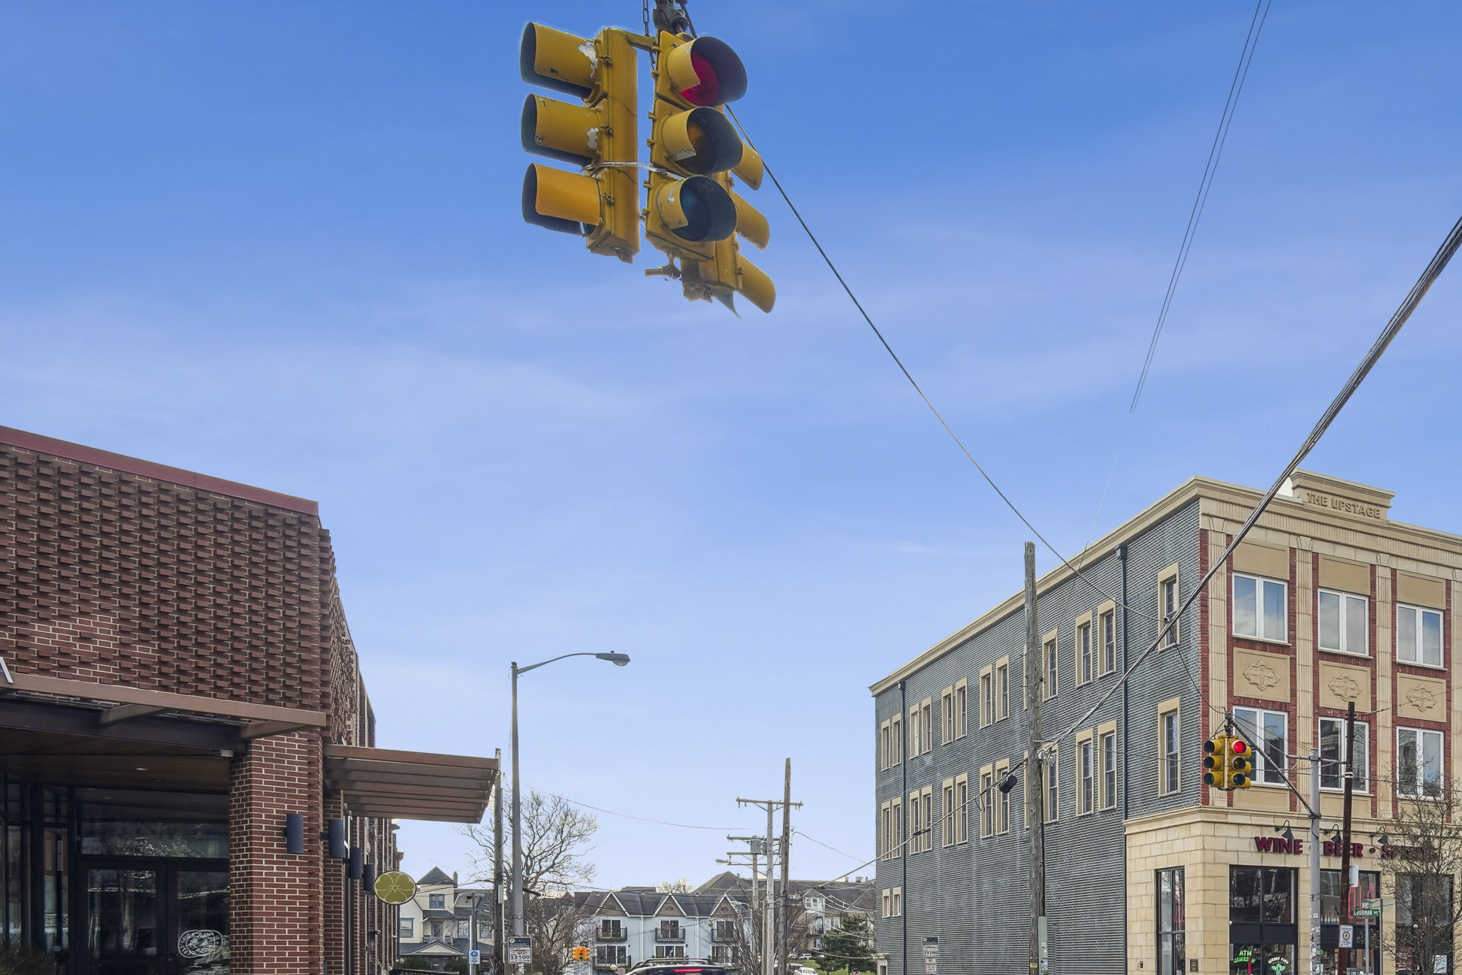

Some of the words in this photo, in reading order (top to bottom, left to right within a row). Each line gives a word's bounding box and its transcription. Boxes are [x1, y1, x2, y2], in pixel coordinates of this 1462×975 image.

[1306, 492, 1328, 507] THE
[1331, 498, 1381, 519] UPSTAGE
[1255, 836, 1303, 854] WINE
